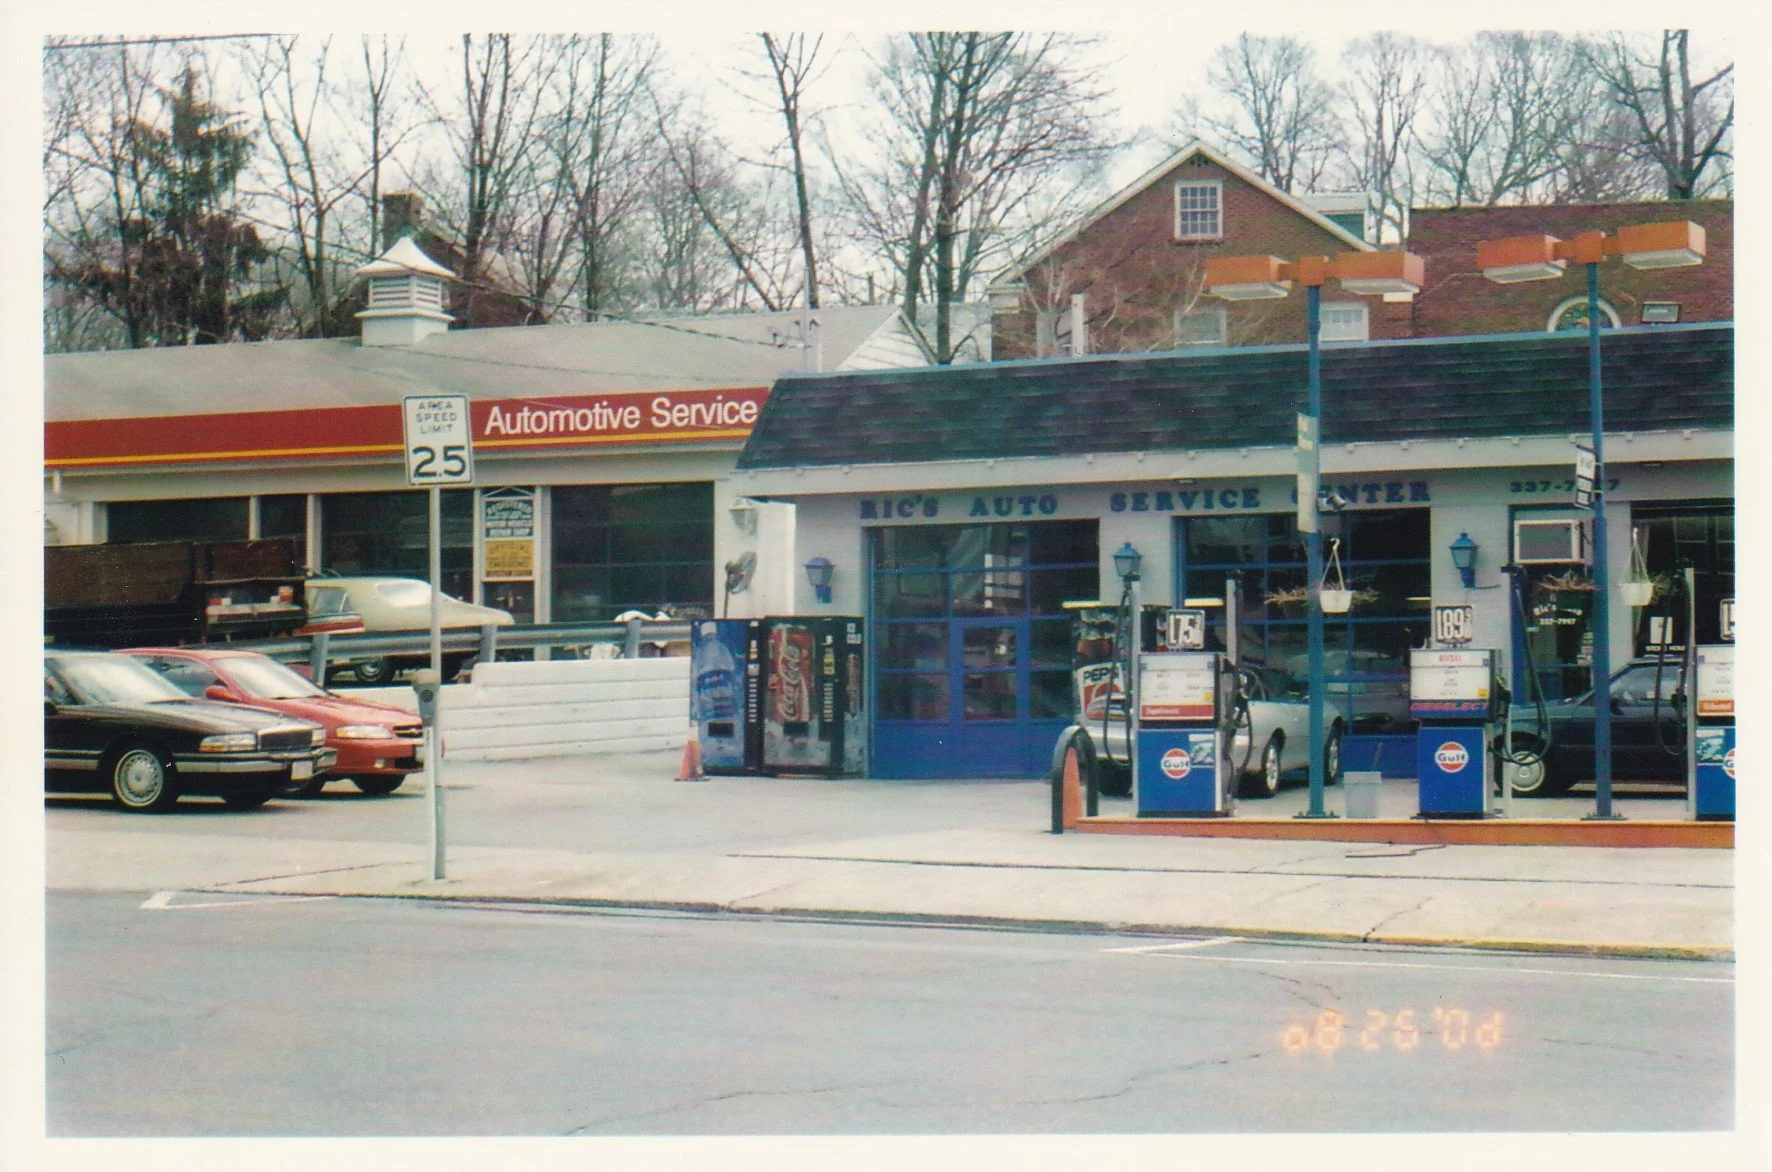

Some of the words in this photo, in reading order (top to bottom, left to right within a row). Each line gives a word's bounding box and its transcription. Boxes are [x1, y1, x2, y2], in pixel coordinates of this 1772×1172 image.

[418, 401, 453, 410] AREA
[416, 412, 458, 423] SPEED
[484, 400, 641, 435] Automotive
[651, 394, 759, 428] Service
[420, 424, 453, 434] LIMIT
[412, 445, 467, 478] 25
[860, 494, 939, 520] RIC'S
[969, 494, 1058, 516] AUTO
[1110, 487, 1261, 512] SERVICE
[1437, 753, 1467, 762] Gulf
[1163, 759, 1190, 768] Gulf
